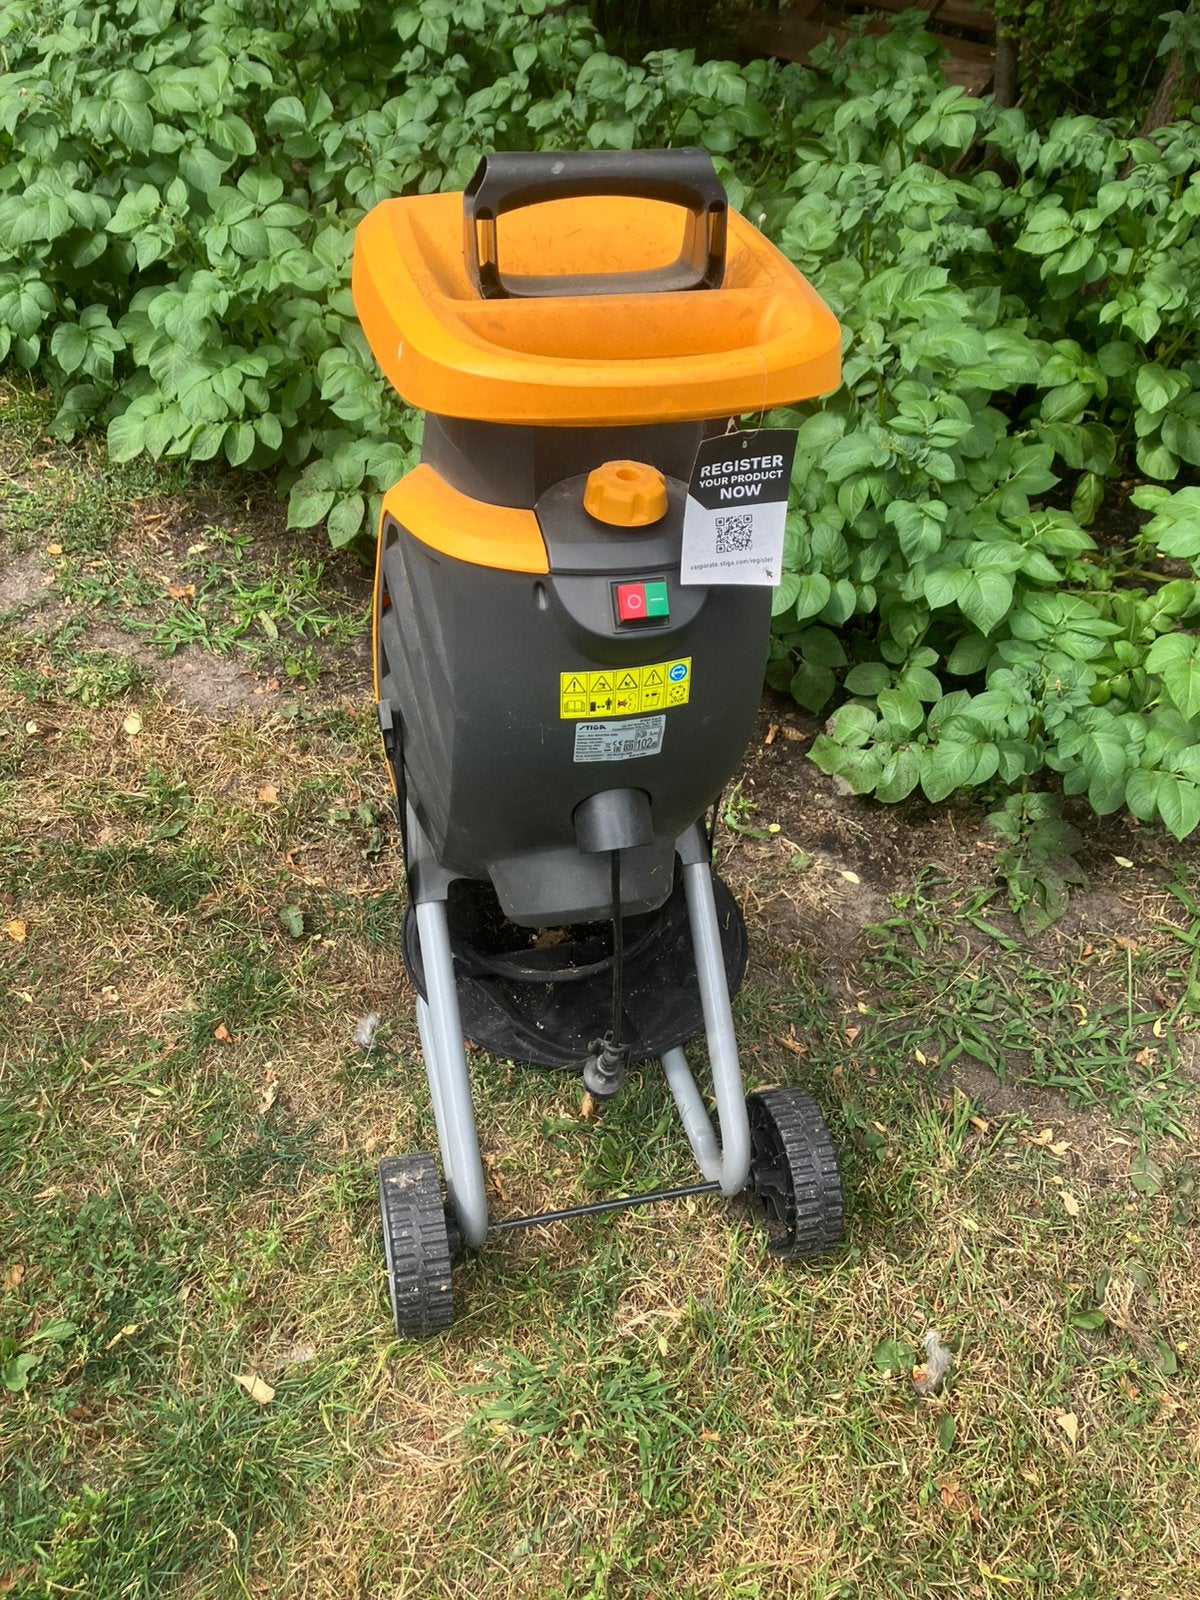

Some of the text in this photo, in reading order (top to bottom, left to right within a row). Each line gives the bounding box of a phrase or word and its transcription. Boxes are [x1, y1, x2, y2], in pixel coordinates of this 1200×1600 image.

[700, 454, 783, 477] REGISTER
[699, 469, 784, 489] YOUR PRODUCT
[720, 484, 762, 500] NOW
[691, 557, 773, 570] corporate.stiga.com/register
[637, 737, 653, 750] 102
